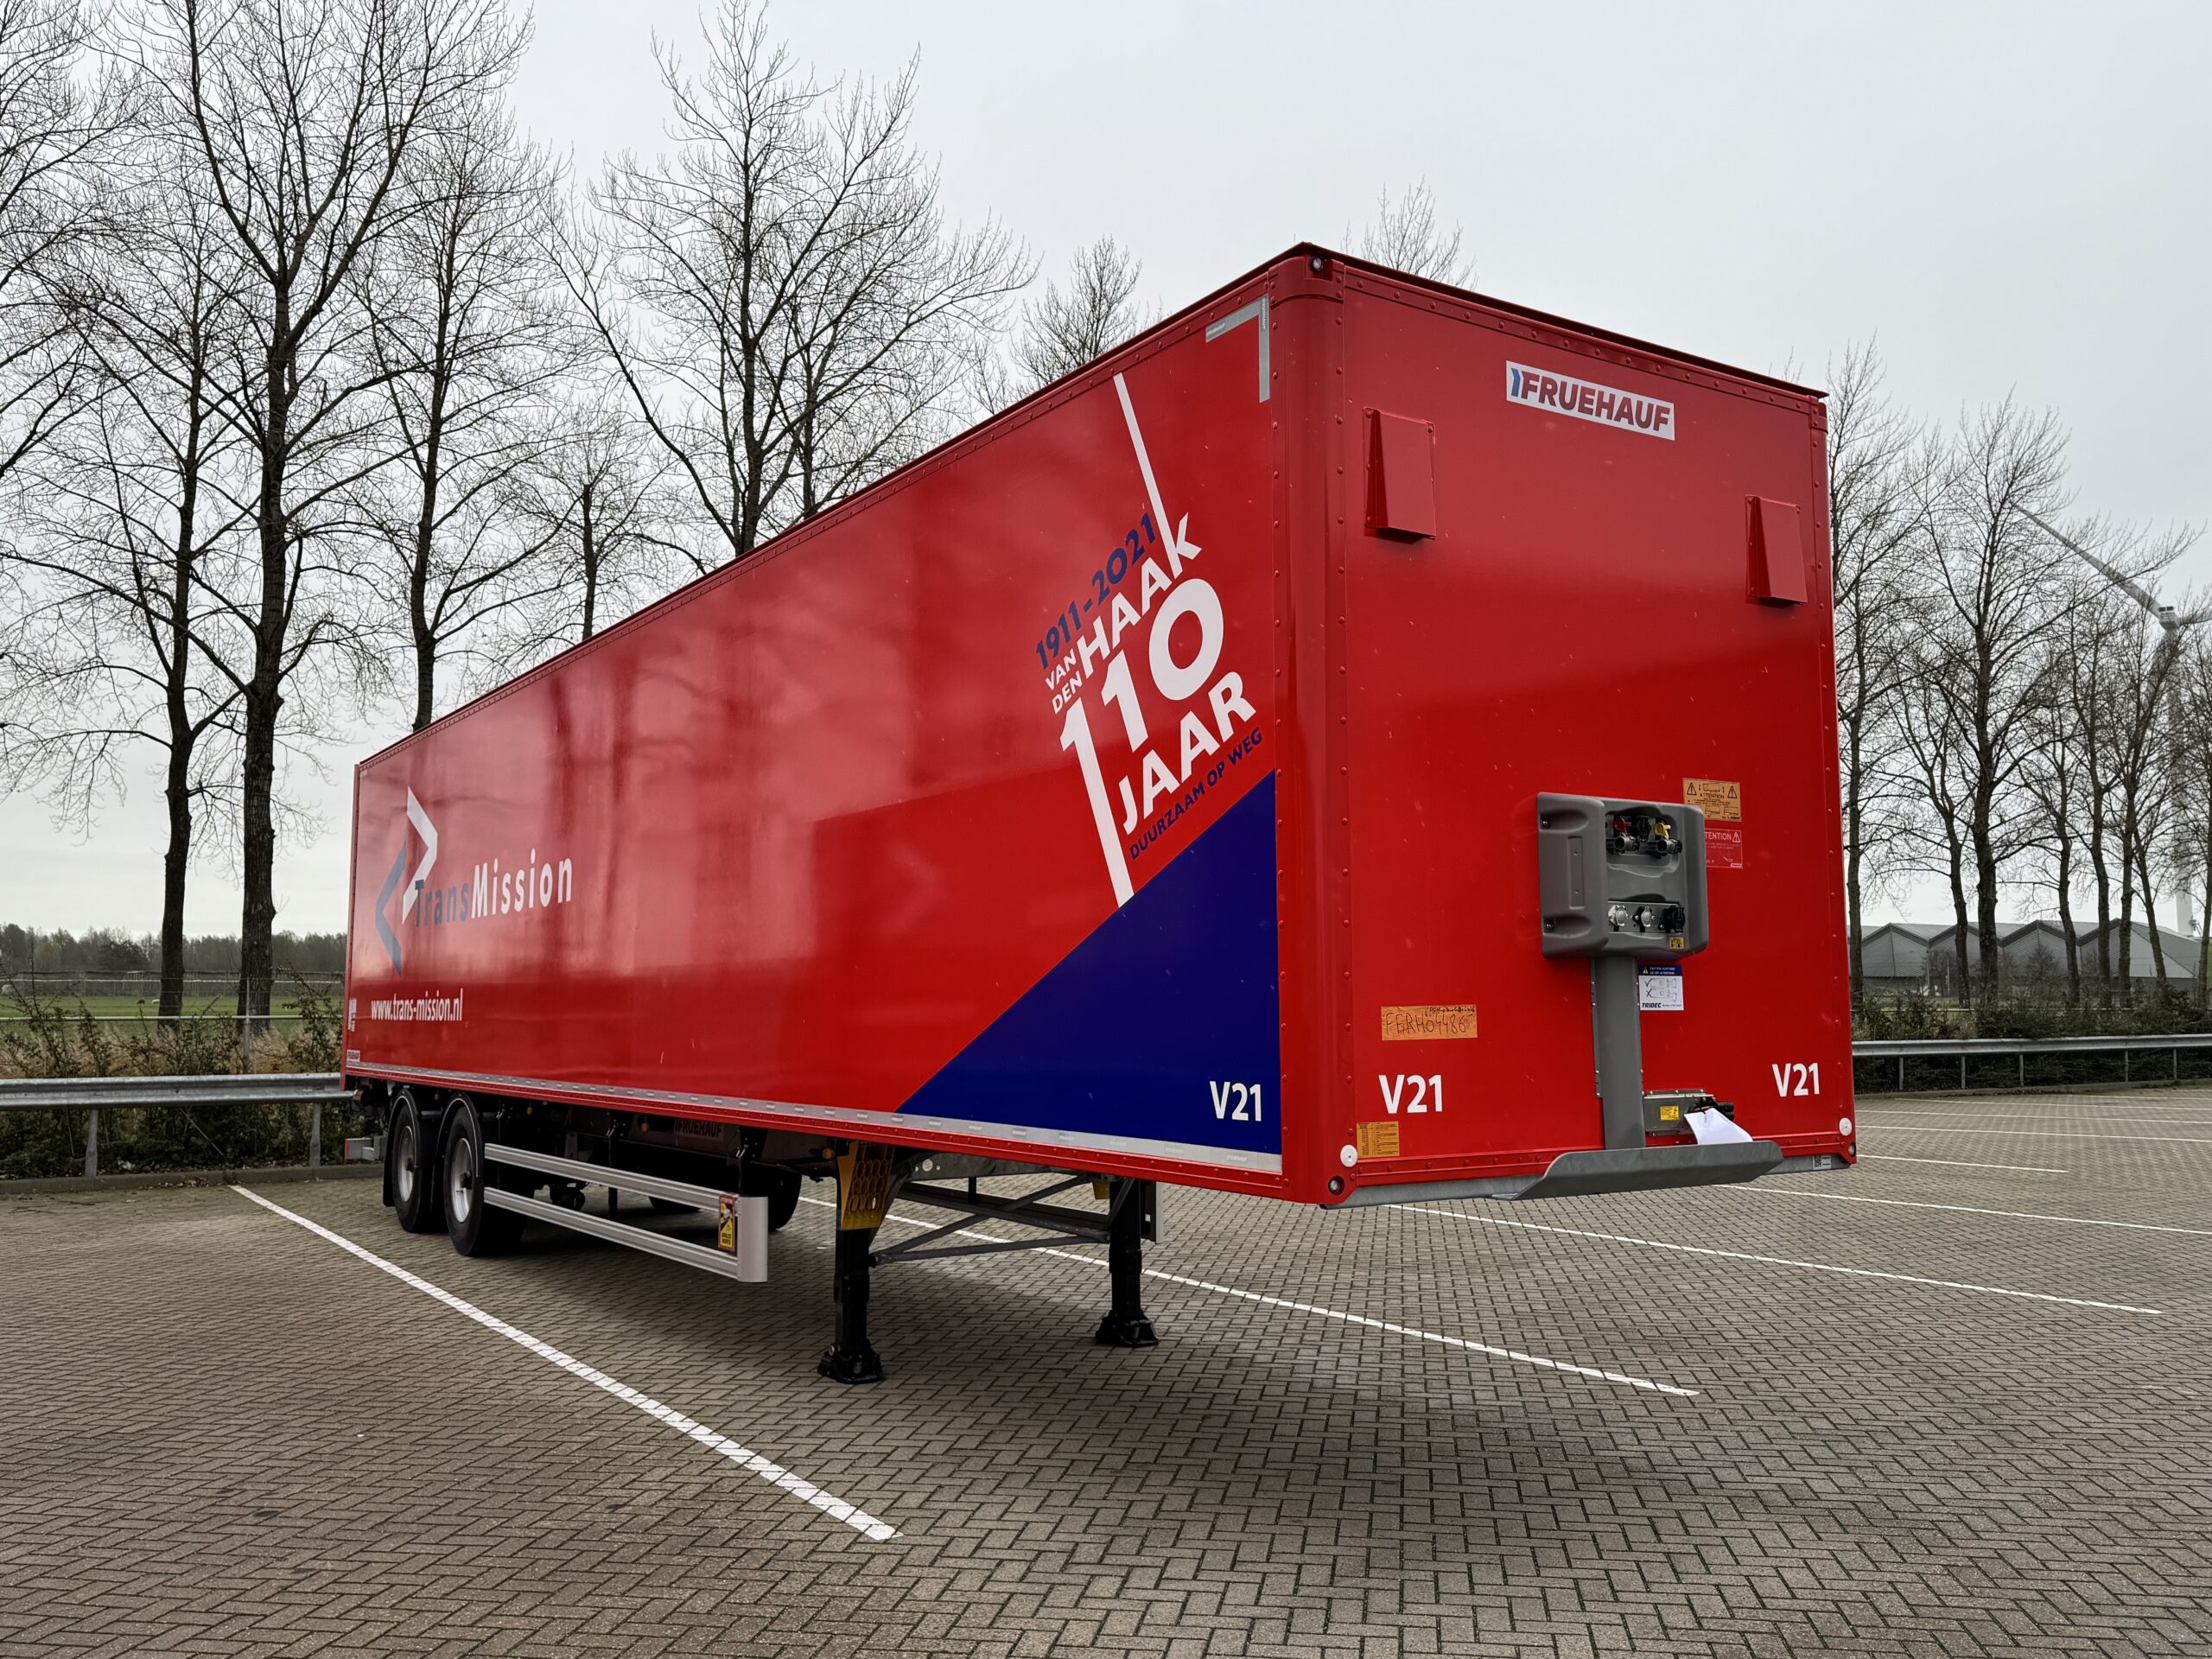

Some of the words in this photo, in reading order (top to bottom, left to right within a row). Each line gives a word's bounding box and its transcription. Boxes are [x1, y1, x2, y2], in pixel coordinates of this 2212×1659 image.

[1521, 371, 1670, 431] FRUEHAUF
[1077, 372, 1202, 679] HAAK
[1036, 512, 1155, 671] 1911-2021
[1045, 648, 1077, 690] VAN
[1051, 671, 1083, 715] DEN
[1118, 671, 1256, 836] JAAR
[1129, 781, 1205, 861] DUURZAAM
[1206, 760, 1225, 787] OP
[1227, 727, 1263, 766] WEG
[1704, 831, 1732, 841] TENTION
[415, 848, 572, 927] TransMission
[371, 988, 463, 1021] www.trans-mission.nl
[1209, 1080, 1262, 1122] V21
[1378, 1074, 1442, 1114] V21
[1771, 1062, 1820, 1097] V21
